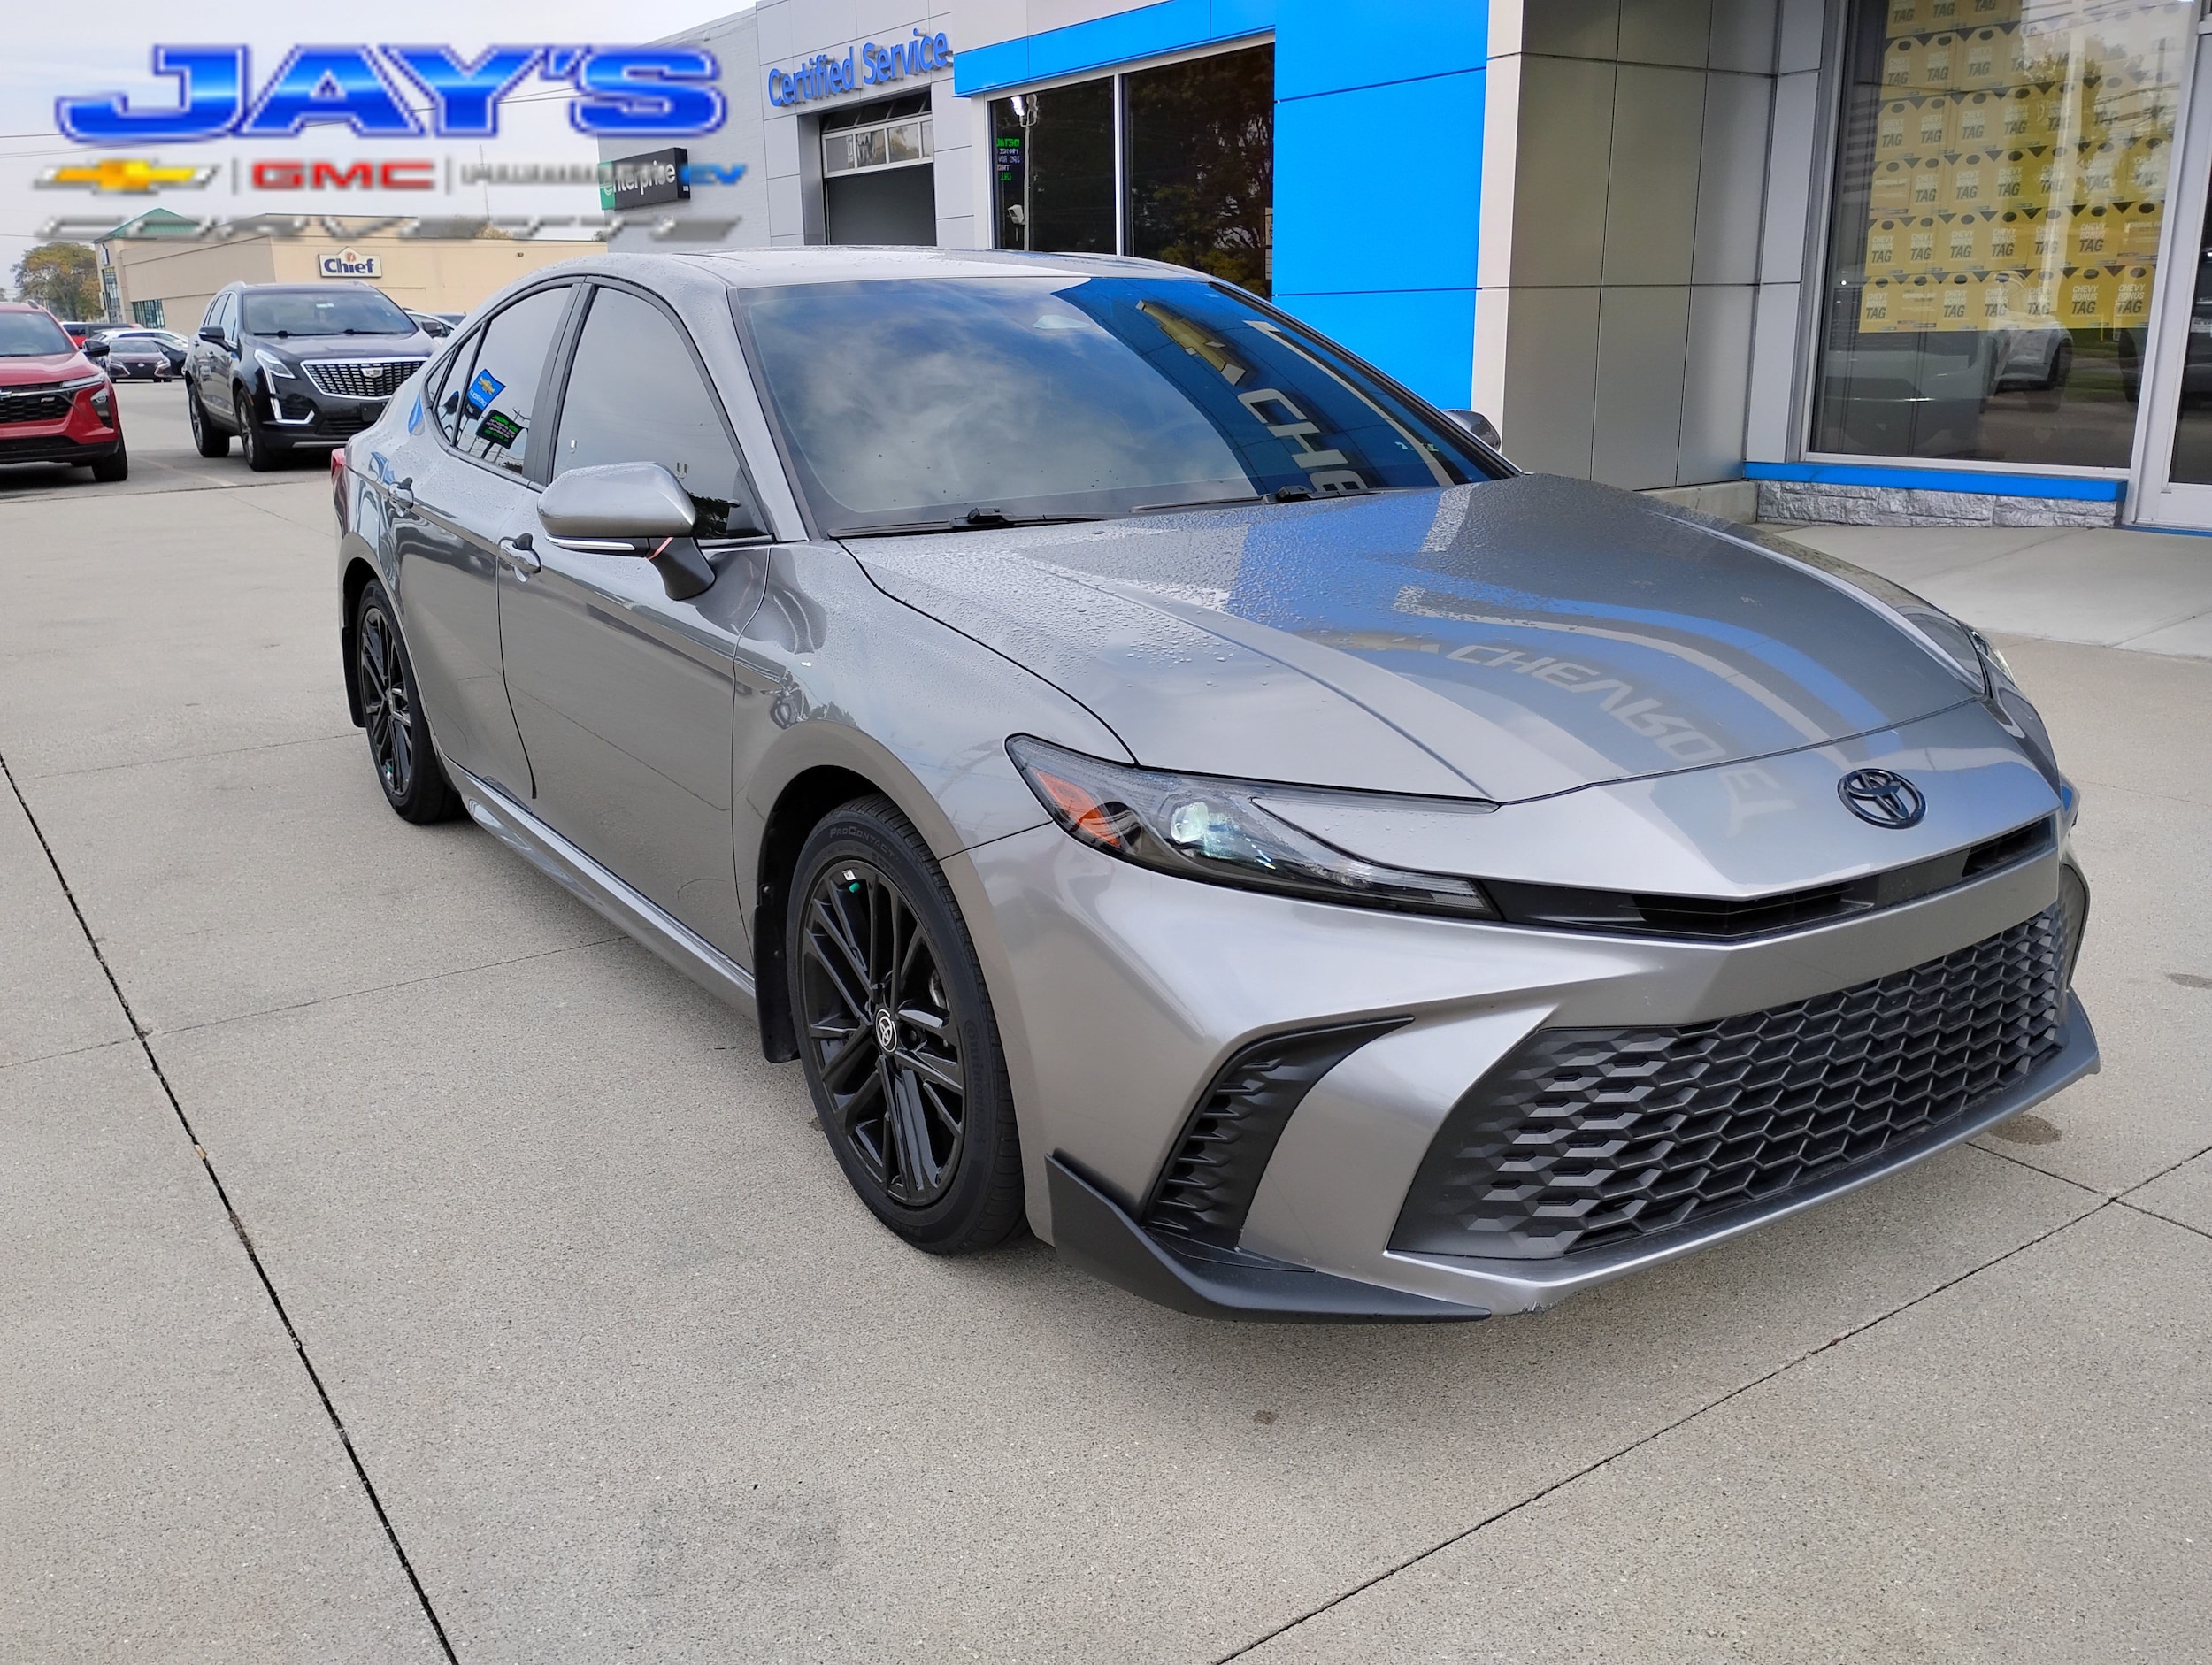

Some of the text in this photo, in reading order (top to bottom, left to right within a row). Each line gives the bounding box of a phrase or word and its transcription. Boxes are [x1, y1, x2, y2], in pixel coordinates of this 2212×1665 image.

[1933, 3, 1955, 18] TAG
[1975, 0, 1997, 12] TAG
[1893, 9, 1914, 23] TAG
[768, 27, 949, 107] Certified Service
[1969, 62, 1991, 77] TAG
[1888, 73, 1909, 85] TAG
[1927, 67, 1948, 81] TAG
[1962, 126, 1984, 139] TAG
[2004, 120, 2028, 134] TAG
[1882, 134, 1902, 148] TAG
[1921, 130, 1942, 143] TAG
[1956, 169, 1981, 179] CHEVY
[1998, 166, 2024, 177] CHEVY
[1916, 188, 1937, 203] TAG
[1955, 186, 1978, 200] TAG
[1997, 182, 2021, 197] TAG
[1993, 227, 2017, 237] CHEVY
[2080, 222, 2107, 232] CHEVY
[1872, 234, 1894, 243] CHEVY
[1911, 233, 1934, 242] CHEVY
[1951, 230, 1975, 239] CHEVY
[1992, 234, 2016, 244] BONUS
[2079, 230, 2106, 240] BONUS
[1910, 240, 1933, 249] BONUS
[1950, 237, 1974, 246] BONUS
[2078, 238, 2104, 253] TAG
[1910, 247, 1932, 260] TAG
[1949, 245, 1972, 258] TAG
[1992, 243, 2015, 257] TAG
[2034, 242, 2059, 255] TAG
[1871, 250, 1893, 264] TAG
[324, 257, 374, 273] Chief
[1944, 289, 1968, 298] CHEVY
[2072, 284, 2099, 293] CHEVY
[2118, 283, 2146, 292] CHEVY
[1867, 292, 1889, 301] CHEVY
[1944, 296, 1967, 305] BONUS
[2071, 292, 2098, 302] BONUS
[2117, 291, 2145, 301] BONUS
[1865, 307, 1886, 319] TAG
[1943, 305, 1966, 318] TAG
[1985, 303, 2008, 317] TAG
[2027, 302, 2051, 315] TAG
[2071, 301, 2096, 315] TAG
[2116, 300, 2143, 314] TAG
